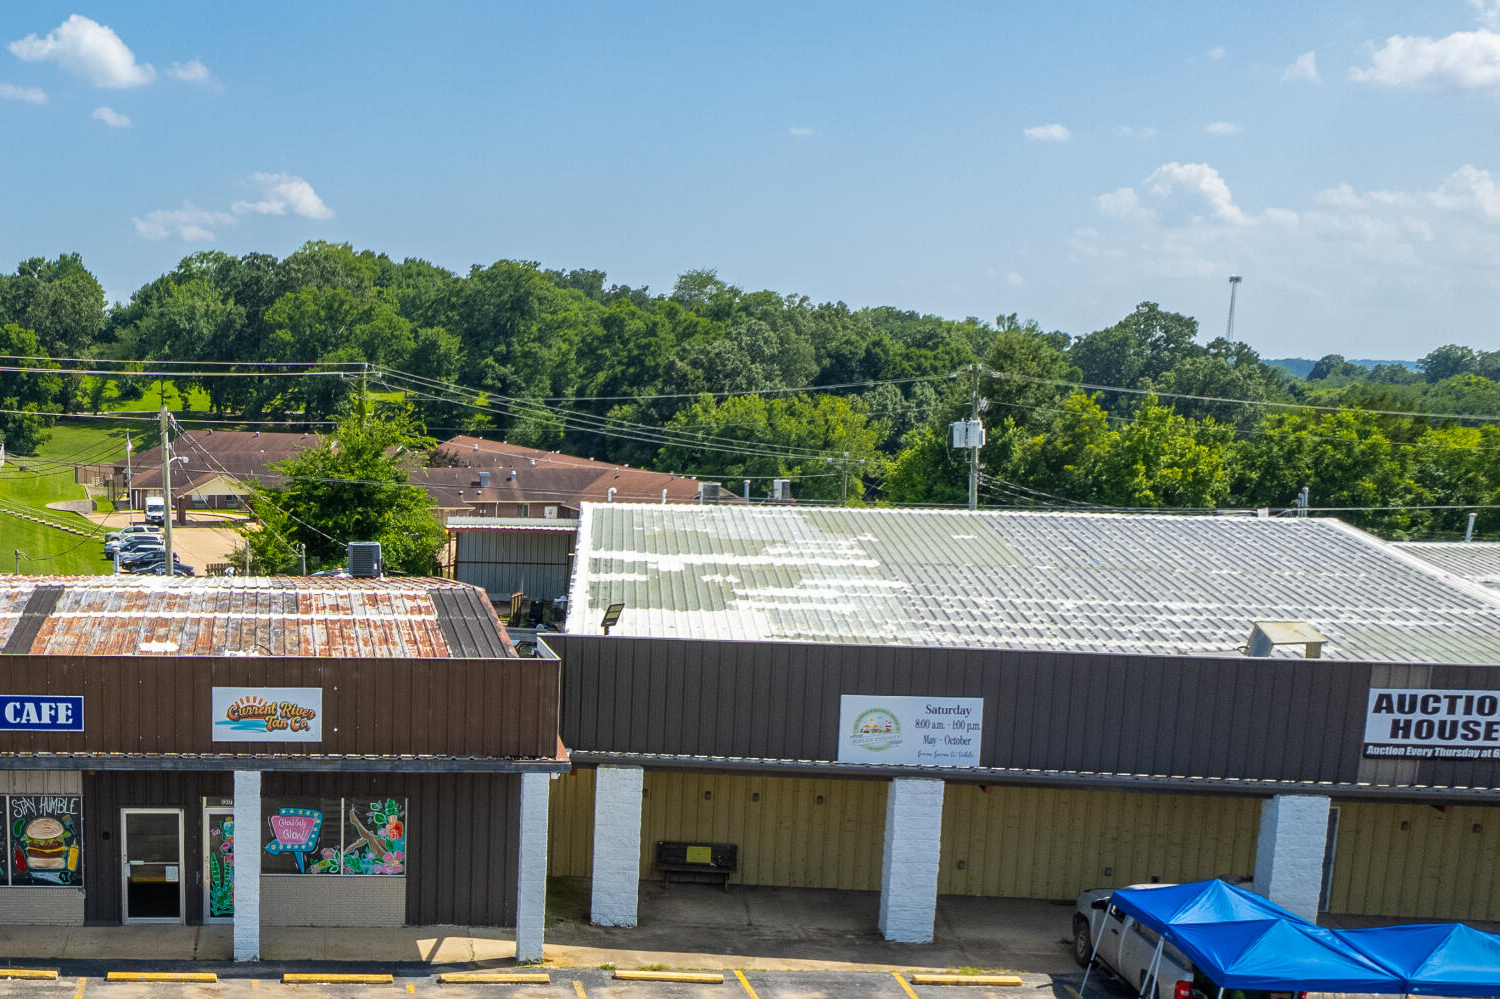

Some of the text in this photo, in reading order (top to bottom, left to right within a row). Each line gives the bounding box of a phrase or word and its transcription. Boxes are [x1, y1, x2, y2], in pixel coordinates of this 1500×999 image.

[4, 702, 73, 724] CAFE
[226, 701, 316, 721] Current River
[925, 704, 972, 718] Saturday
[1372, 693, 1500, 717] AUCTIO
[265, 715, 288, 732] Tan
[1389, 718, 1500, 741] HOUSE
[923, 735, 936, 747] May
[944, 735, 972, 746] October
[1366, 745, 1405, 756] Auction
[1405, 747, 1433, 758] Every
[1434, 747, 1480, 759] Thursday
[1480, 749, 1492, 758] at
[11, 795, 80, 818] STAY HUMBLE
